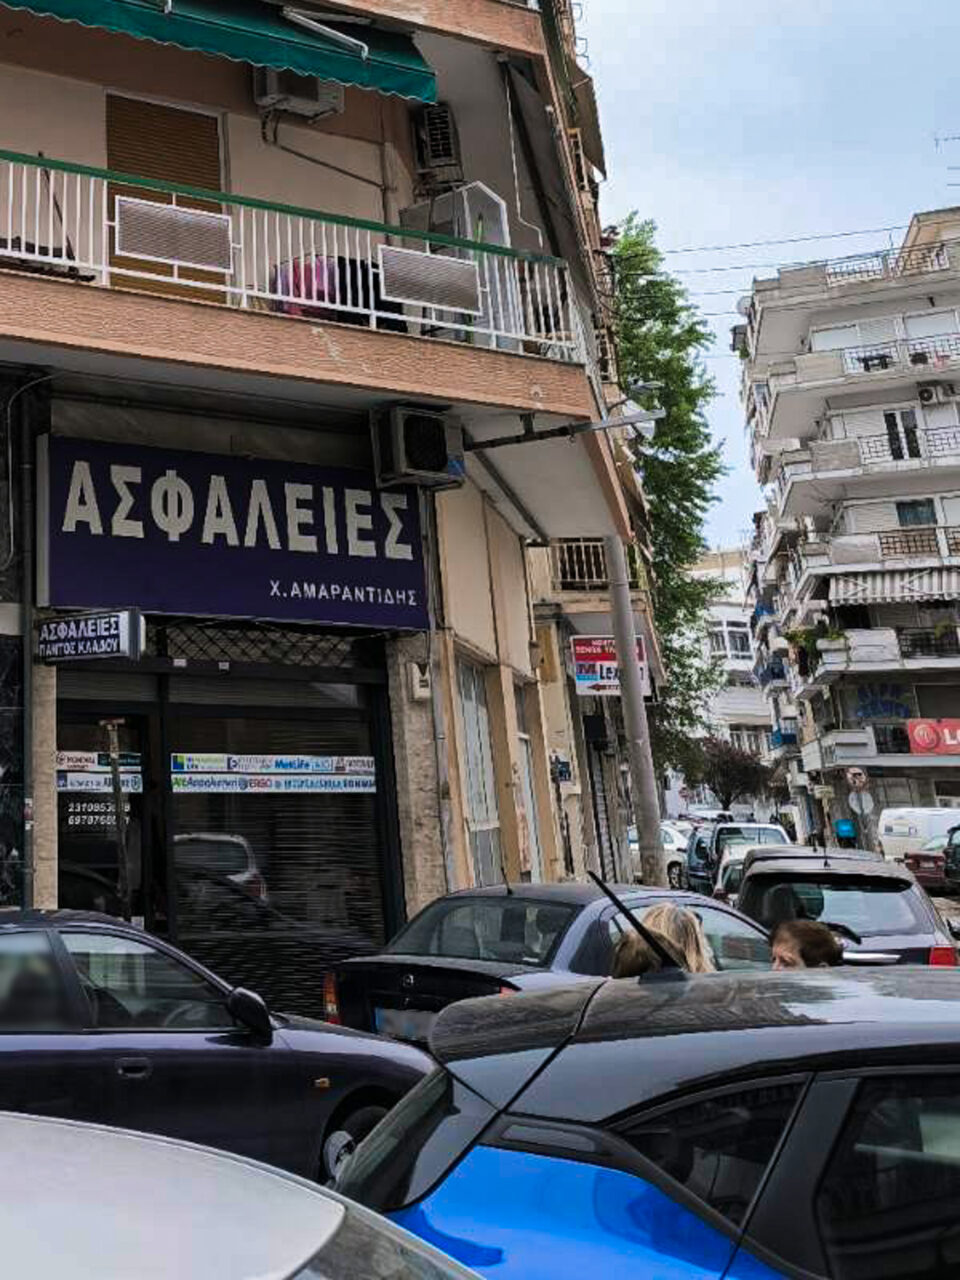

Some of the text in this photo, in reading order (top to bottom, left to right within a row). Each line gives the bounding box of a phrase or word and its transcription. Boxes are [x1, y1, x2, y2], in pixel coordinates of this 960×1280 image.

[62, 460, 414, 561] ΑΣΦΑΛΕΙΕΣ
[269, 579, 418, 607] Χ.ΑΜΑΡΑΝΤΙΔΗΣ
[39, 617, 119, 641] ΑΣΦΑΛΕΙΕΣ
[77, 638, 119, 655] ΚΛΑΔΟΥ
[943, 728, 960, 745] L
[274, 757, 310, 770] MetLife
